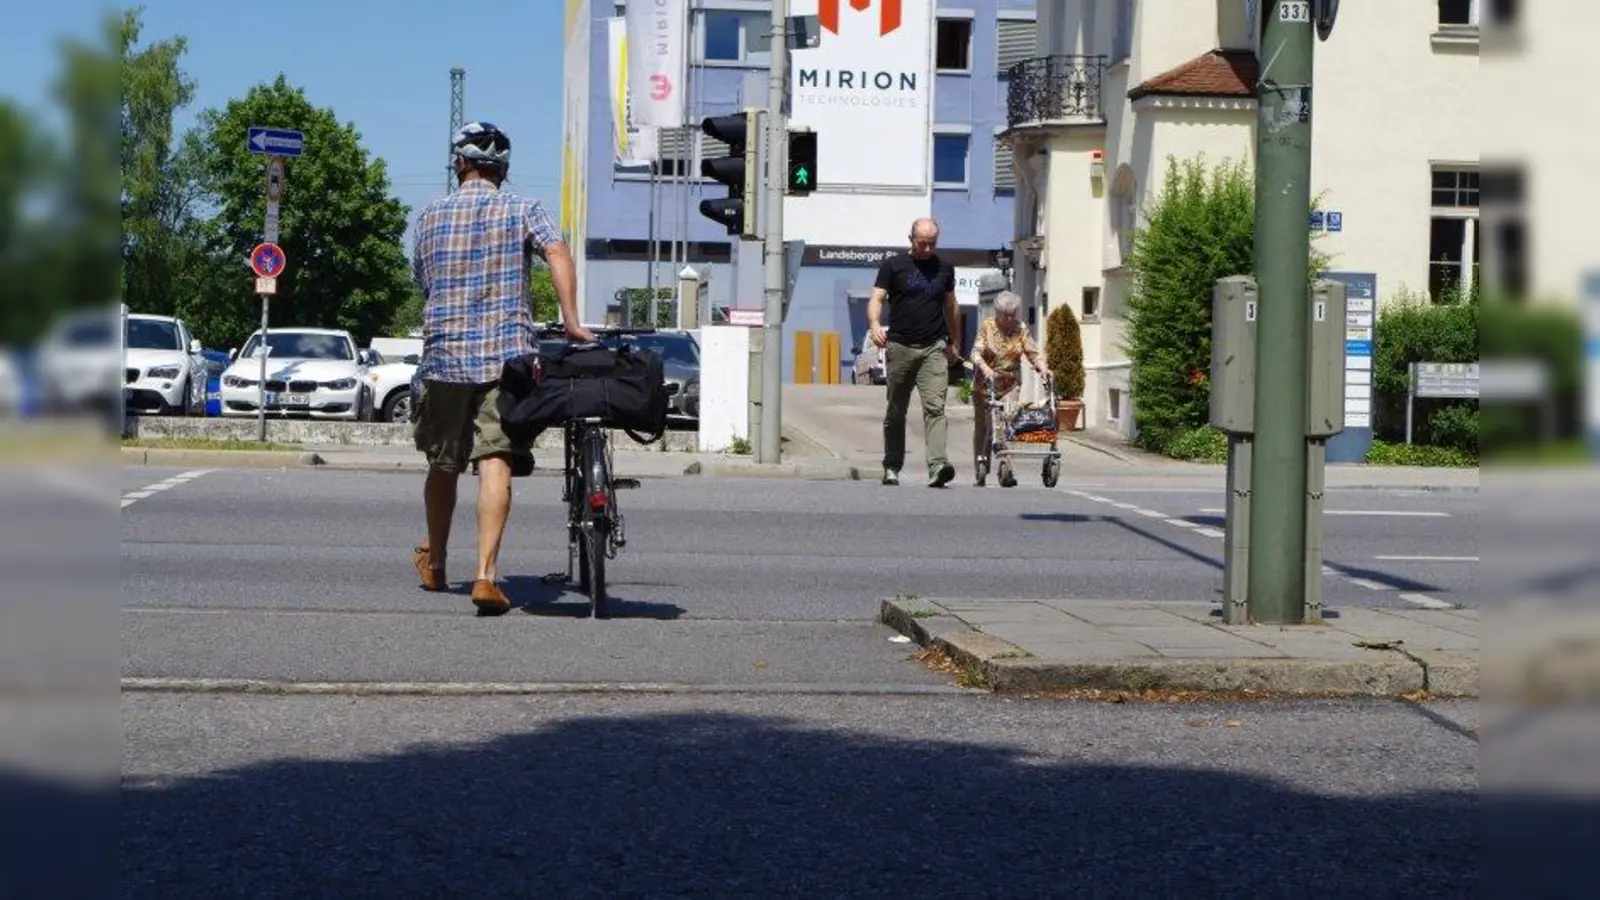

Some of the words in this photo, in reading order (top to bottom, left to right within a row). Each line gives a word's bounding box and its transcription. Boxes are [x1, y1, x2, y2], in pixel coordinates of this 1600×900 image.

[1281, 3, 1309, 19] 337
[799, 69, 917, 91] MIRION
[799, 94, 918, 108] TECHNOLOGIES
[819, 249, 884, 262] Landsberger
